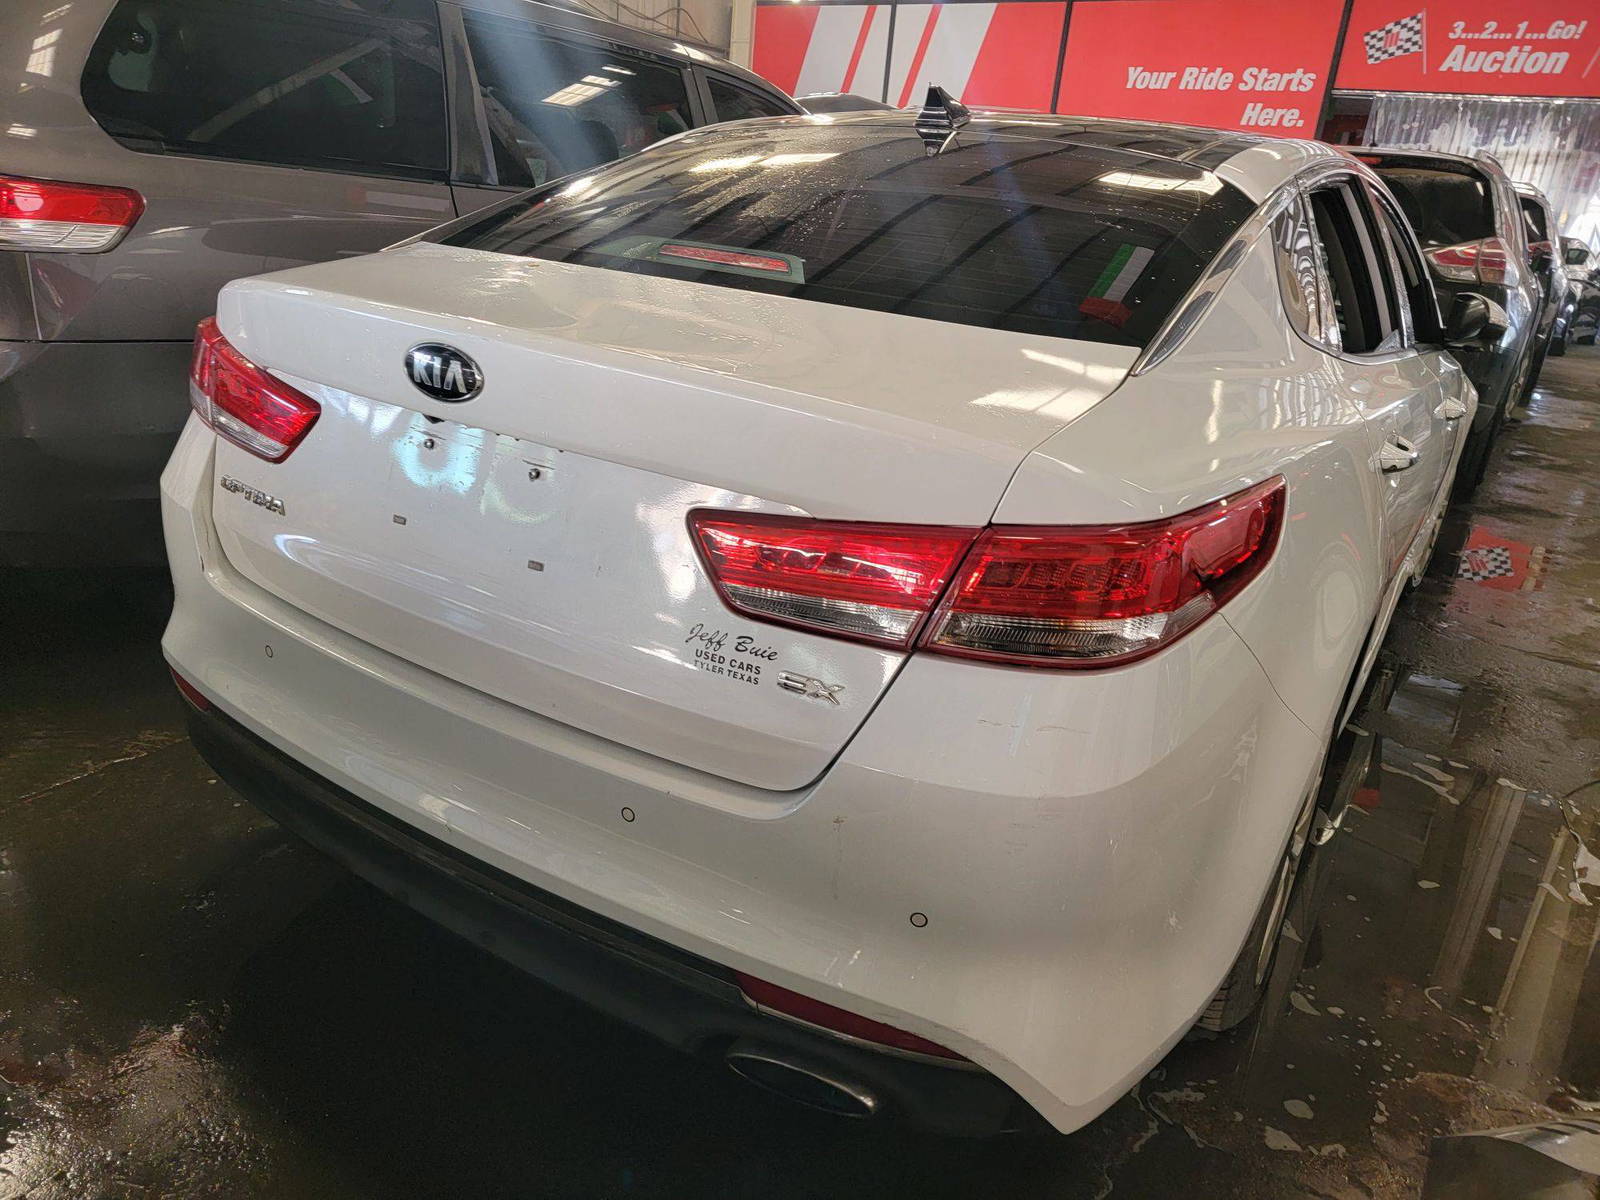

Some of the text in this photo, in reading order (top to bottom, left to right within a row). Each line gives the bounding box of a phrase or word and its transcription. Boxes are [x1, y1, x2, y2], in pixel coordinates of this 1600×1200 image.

[1438, 43, 1570, 76] Auction
[1126, 65, 1317, 94] Your Ride Starts
[1239, 101, 1305, 129] Here.
[412, 350, 470, 394] KIA
[685, 622, 779, 661] Jeff Buie
[693, 658, 760, 686] TYLER TEXAS
[695, 648, 761, 675] USED CARS
[776, 669, 846, 706] EX
